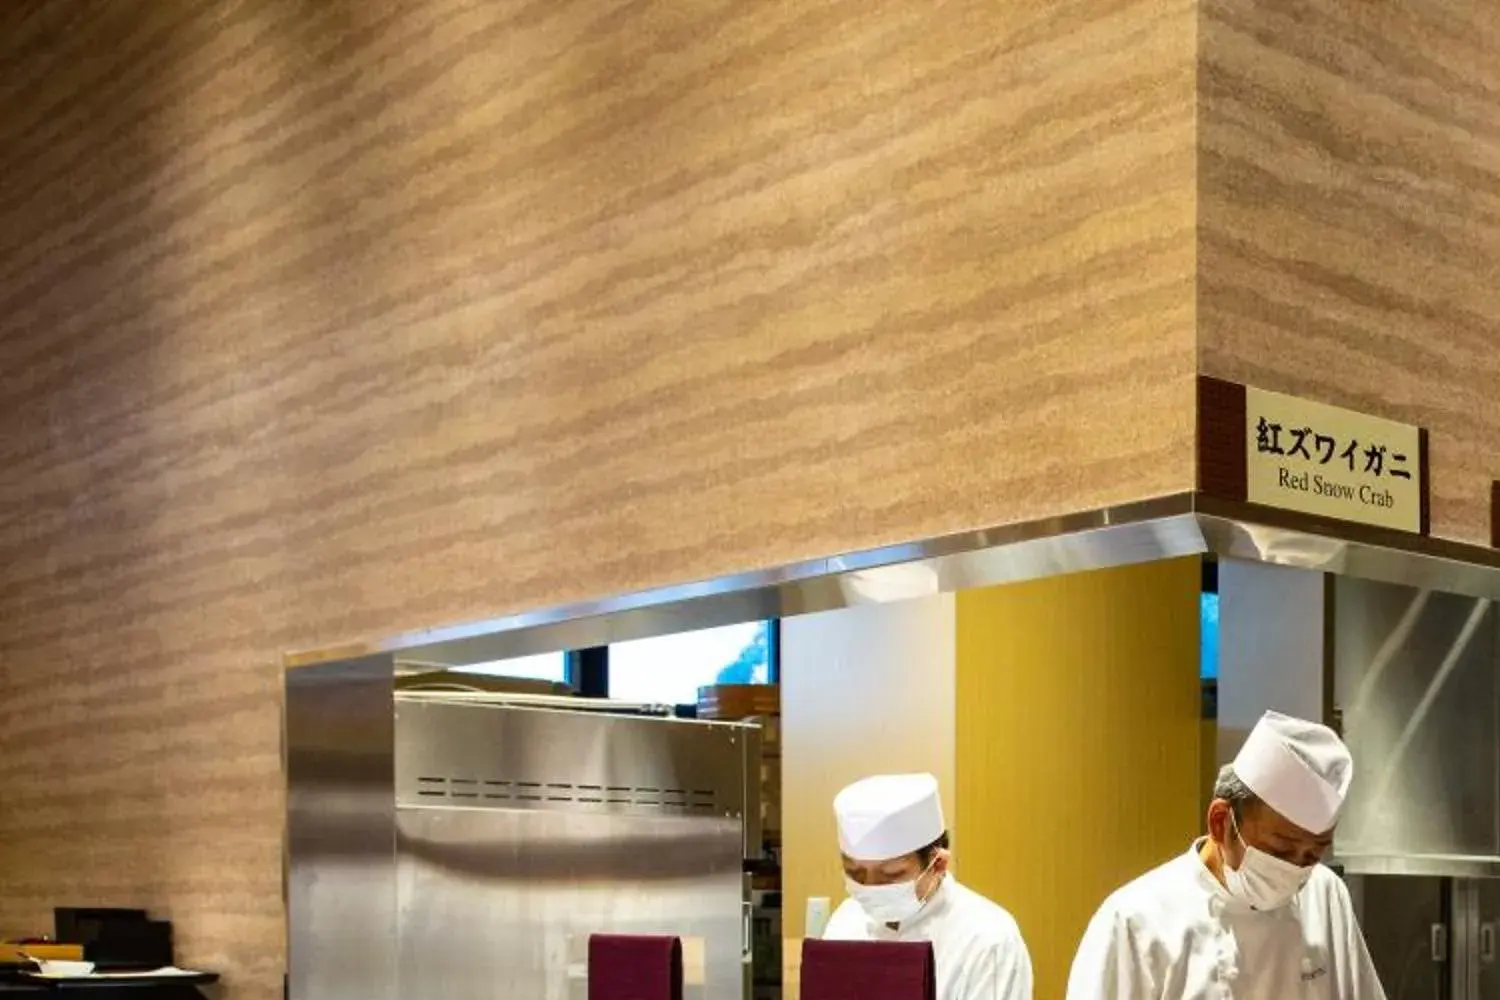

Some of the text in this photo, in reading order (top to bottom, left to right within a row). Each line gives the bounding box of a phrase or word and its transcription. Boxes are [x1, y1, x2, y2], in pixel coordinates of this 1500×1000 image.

[1256, 416, 1411, 480] 紅ズワイガニ
[1279, 467, 1394, 509] Red Snow Crab
